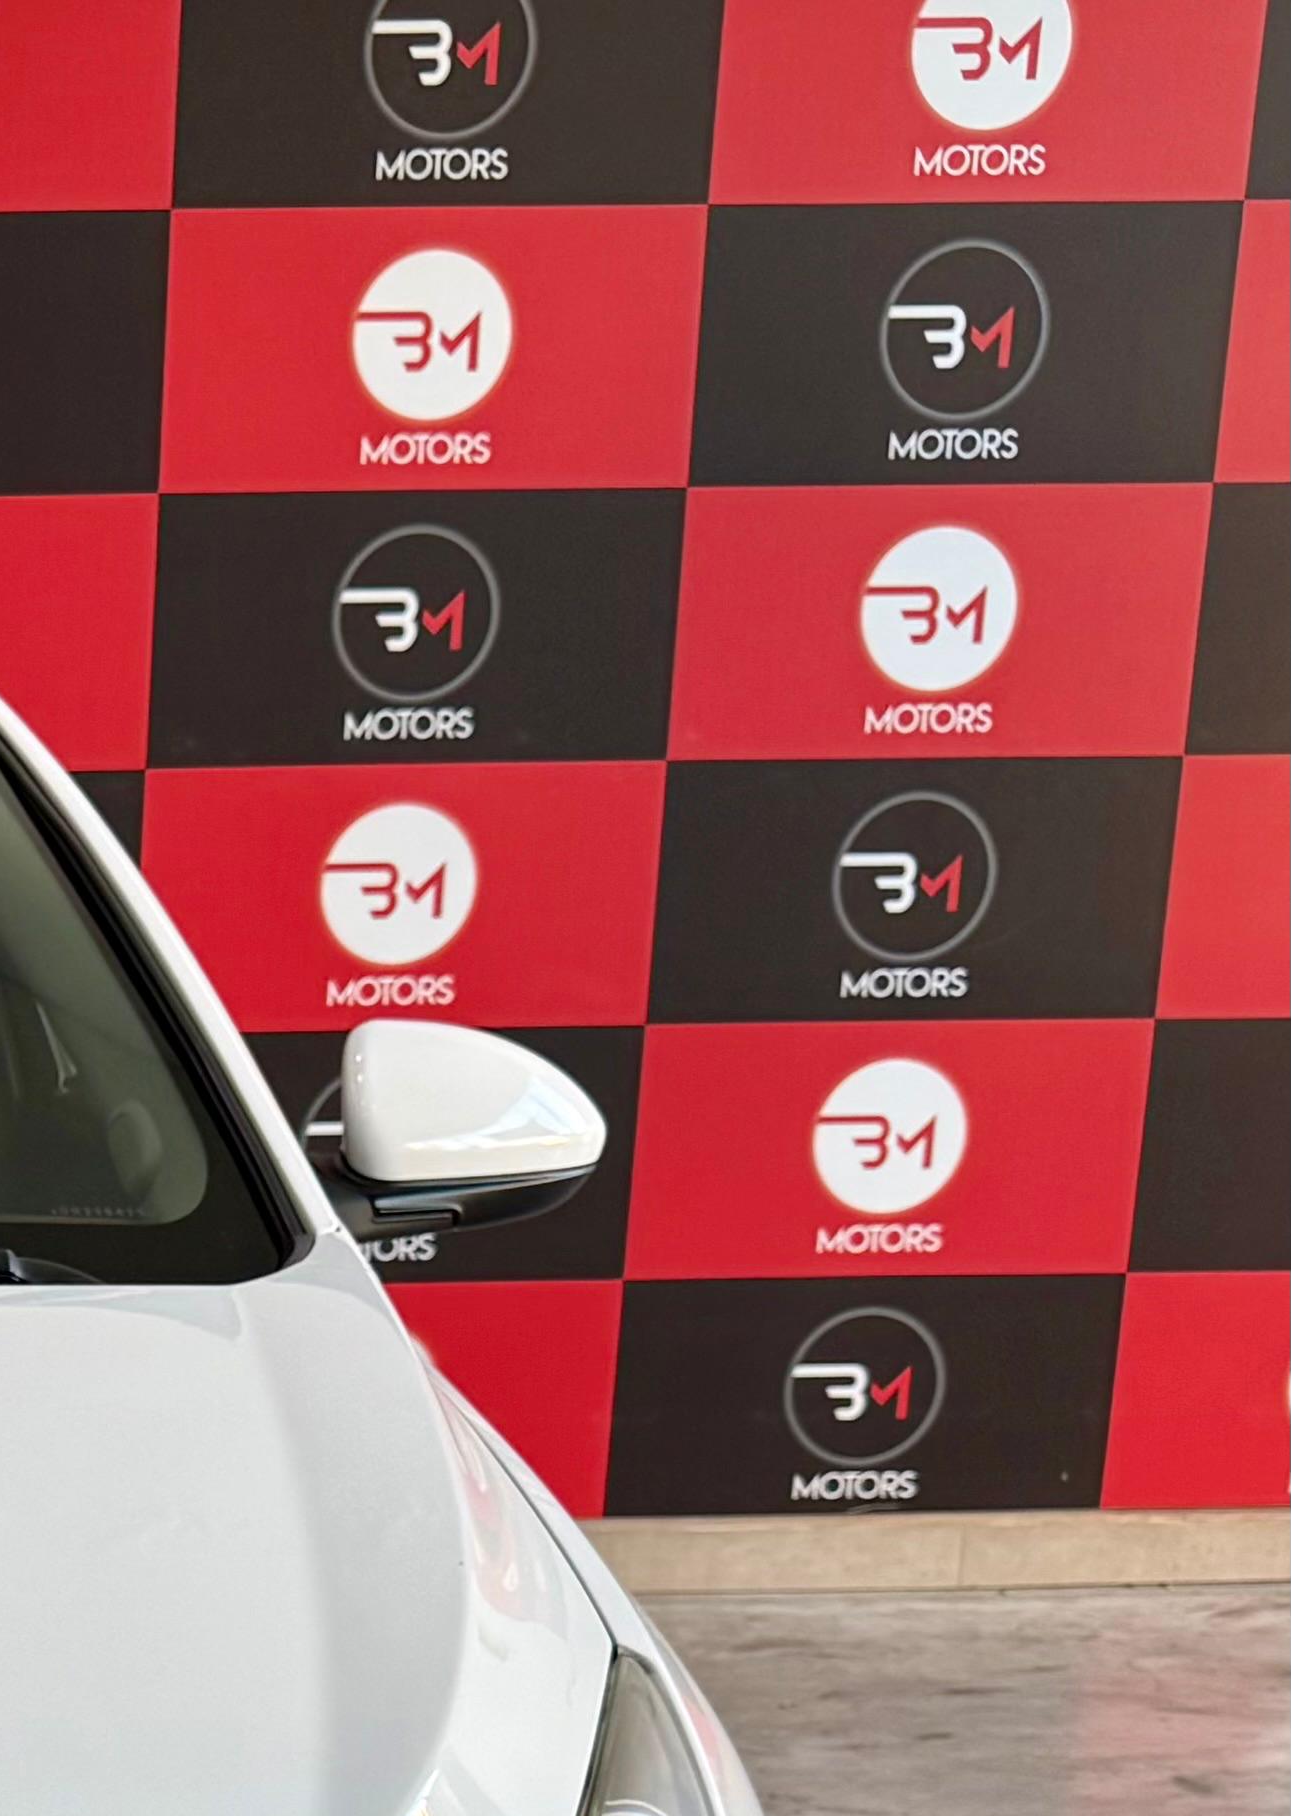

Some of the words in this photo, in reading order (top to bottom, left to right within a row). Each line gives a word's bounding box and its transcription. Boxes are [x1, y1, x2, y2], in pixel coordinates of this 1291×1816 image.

[376, 148, 508, 180] MOTORS
[914, 144, 1045, 176] MOTORS
[360, 433, 490, 464] MOTORS
[889, 428, 1018, 459] MOTORS
[344, 708, 473, 740] MOTORS
[864, 703, 992, 733] MOTORS
[327, 975, 454, 1006] MOTORS
[841, 968, 967, 997] MOTORS
[816, 1224, 942, 1253] MOTORS
[792, 1471, 916, 1499] MOTORS
